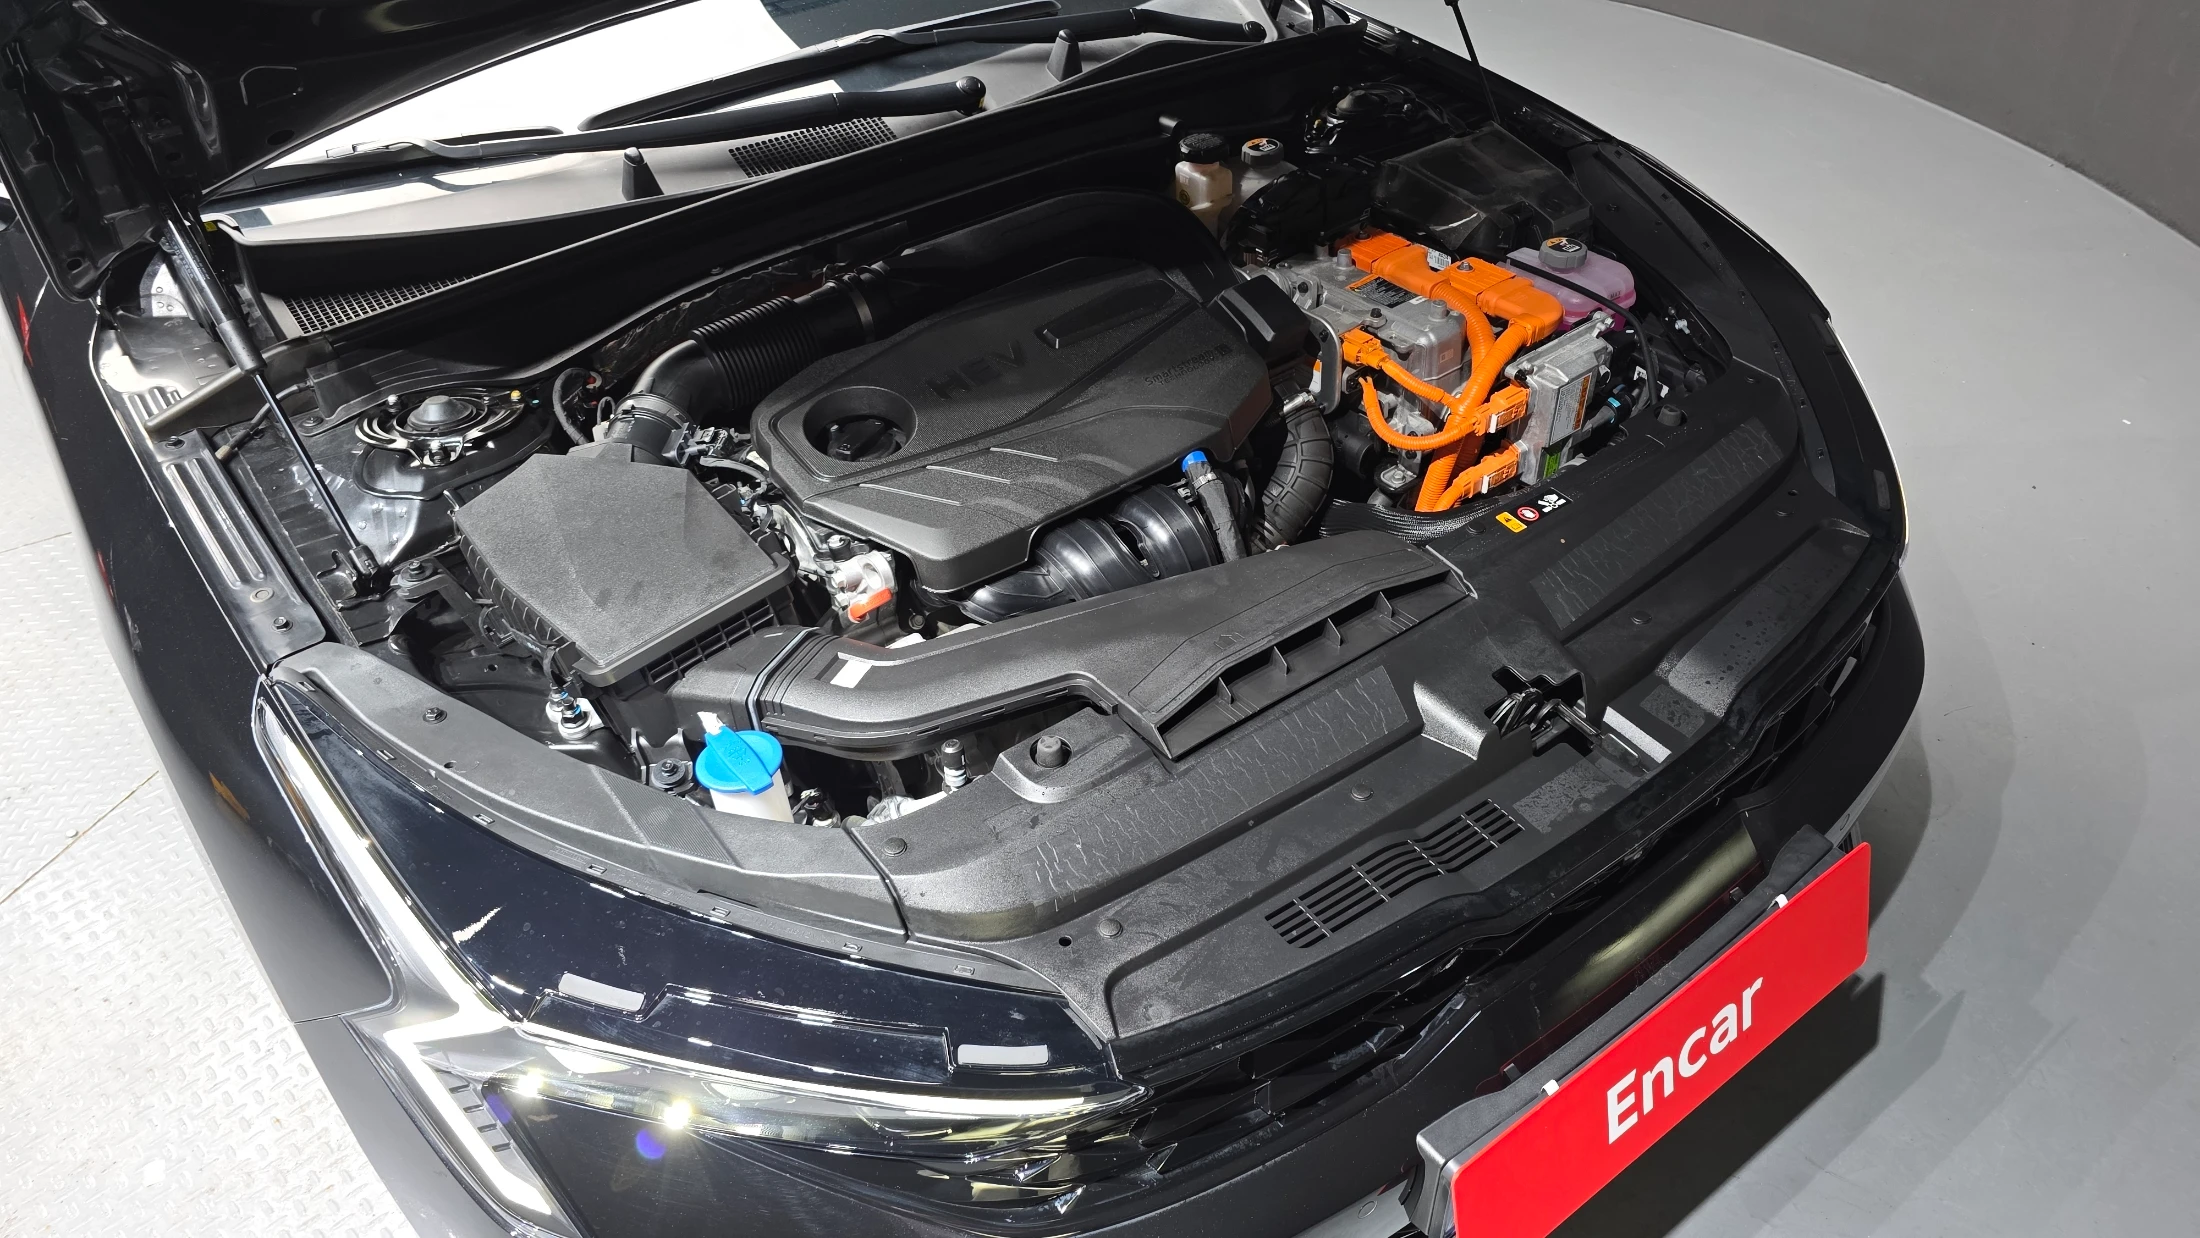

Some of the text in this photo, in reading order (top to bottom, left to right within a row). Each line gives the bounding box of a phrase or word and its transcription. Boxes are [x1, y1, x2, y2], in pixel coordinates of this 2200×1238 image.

[926, 340, 1026, 399] HEV
[1144, 349, 1215, 386] Smartstream
[1606, 976, 1764, 1144] Encar
